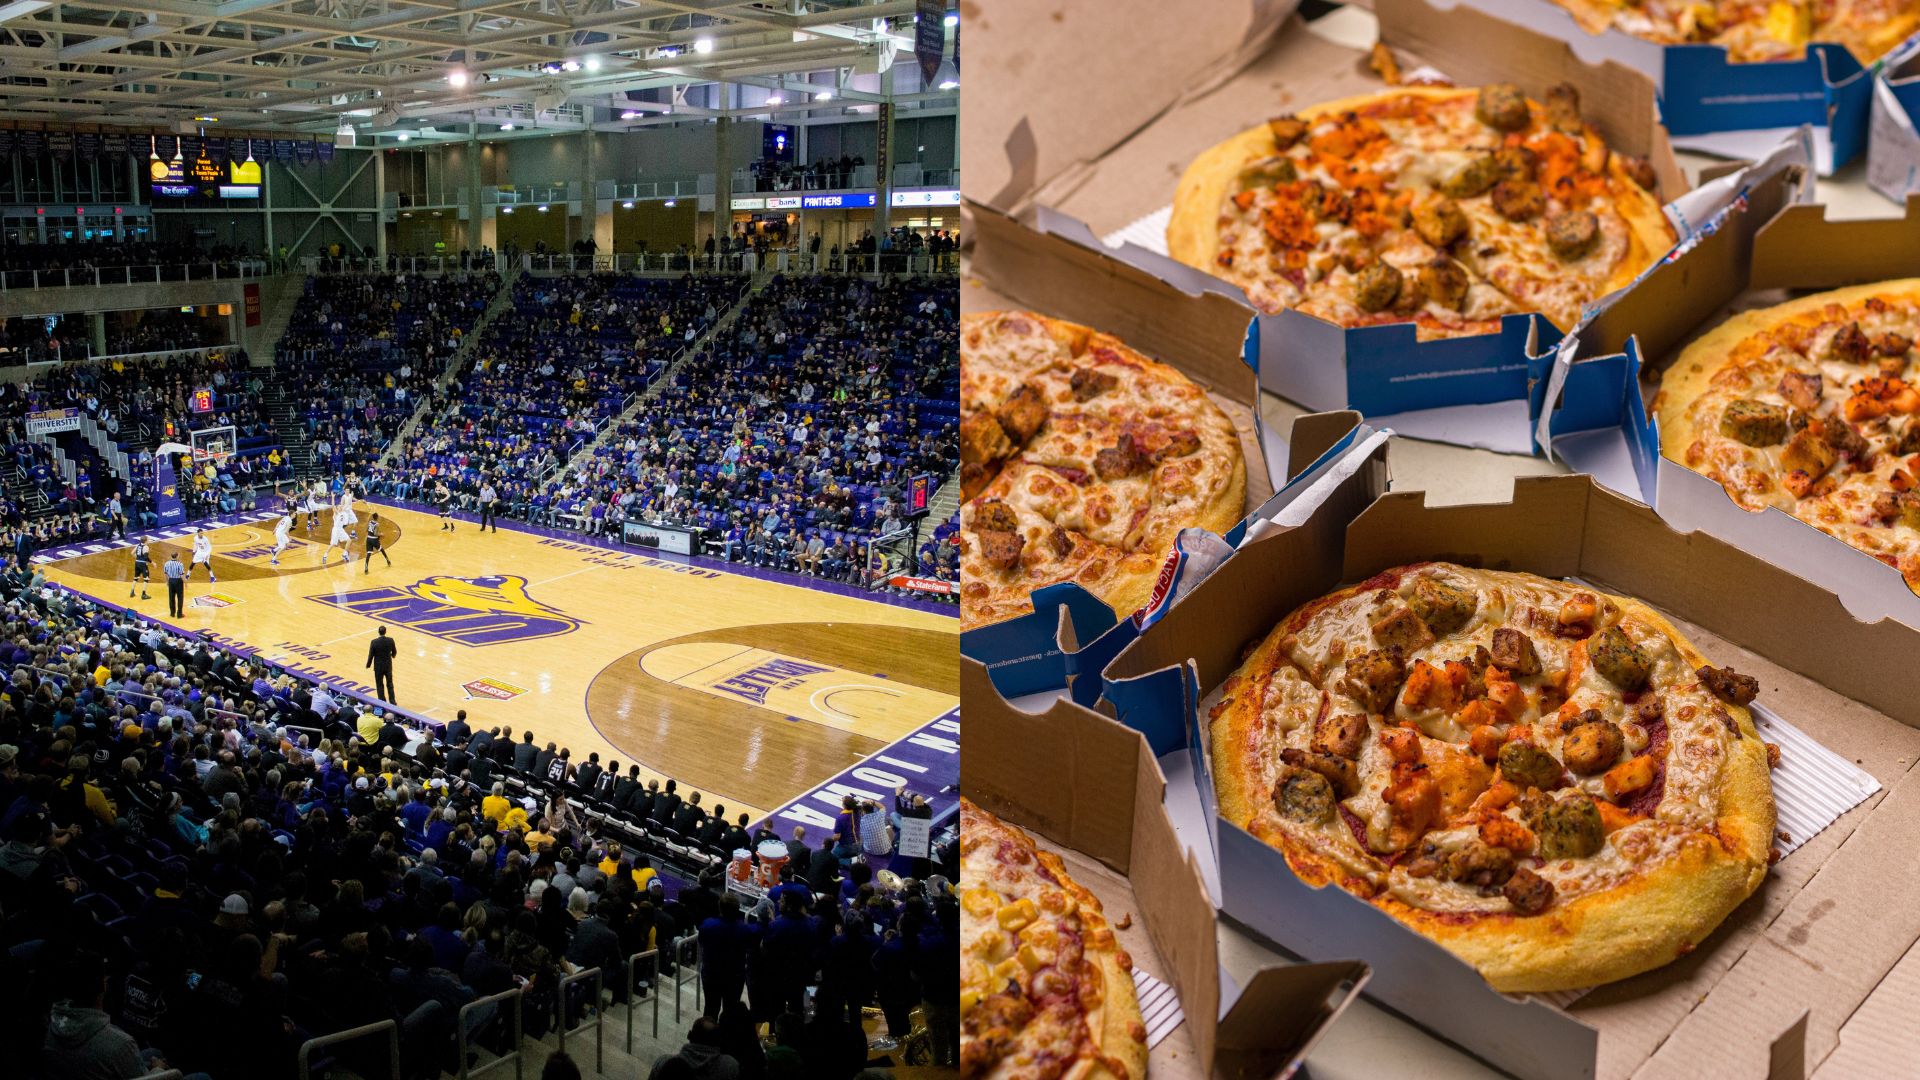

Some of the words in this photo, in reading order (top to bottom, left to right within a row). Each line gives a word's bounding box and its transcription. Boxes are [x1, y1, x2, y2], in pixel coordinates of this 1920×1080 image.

[804, 196, 842, 207] PANTHERS
[869, 195, 875, 205] 5
[28, 417, 78, 435] UNIVERSITY
[538, 538, 615, 557] Robert
[641, 559, 723, 579] McCoy
[581, 557, 636, 570] Court
[712, 658, 835, 705] VALLEY
[548, 766, 563, 781] 24
[601, 779, 608, 791] 1
